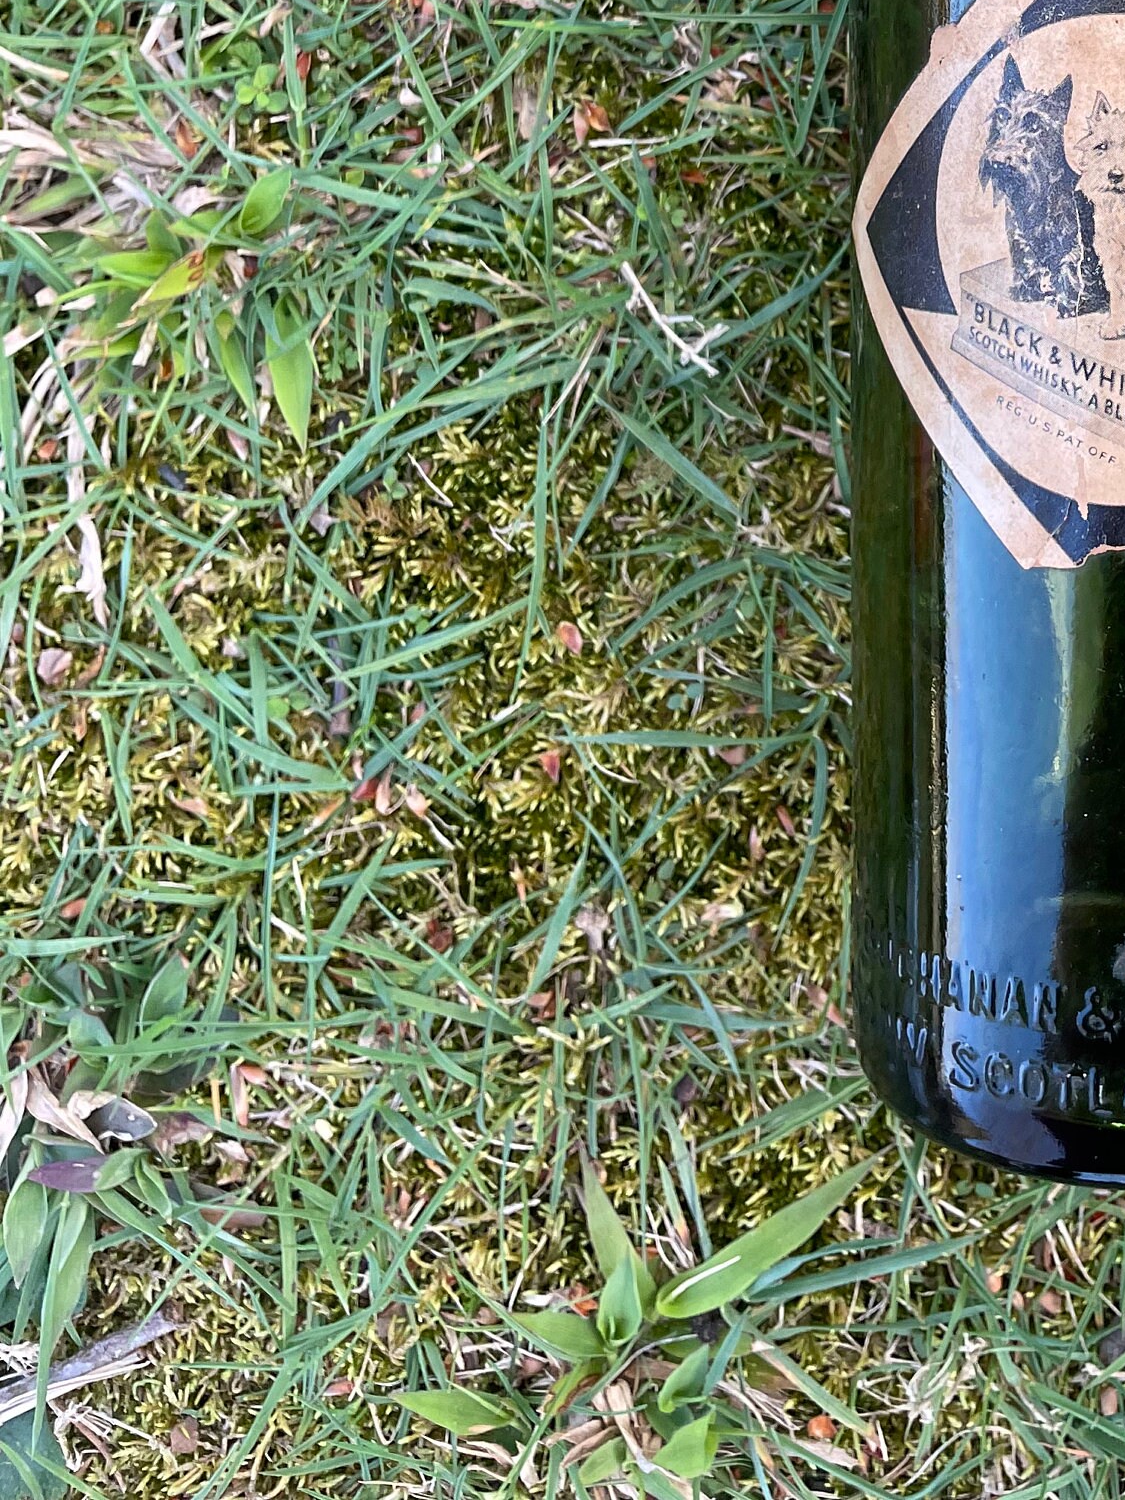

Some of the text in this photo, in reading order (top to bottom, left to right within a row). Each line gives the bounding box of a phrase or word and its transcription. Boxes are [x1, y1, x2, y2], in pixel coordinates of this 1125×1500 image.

[969, 326, 1016, 363] SCOTCH
[1088, 393, 1099, 410] A
[1049, 345, 1062, 367] &
[1076, 986, 1117, 1044] &
